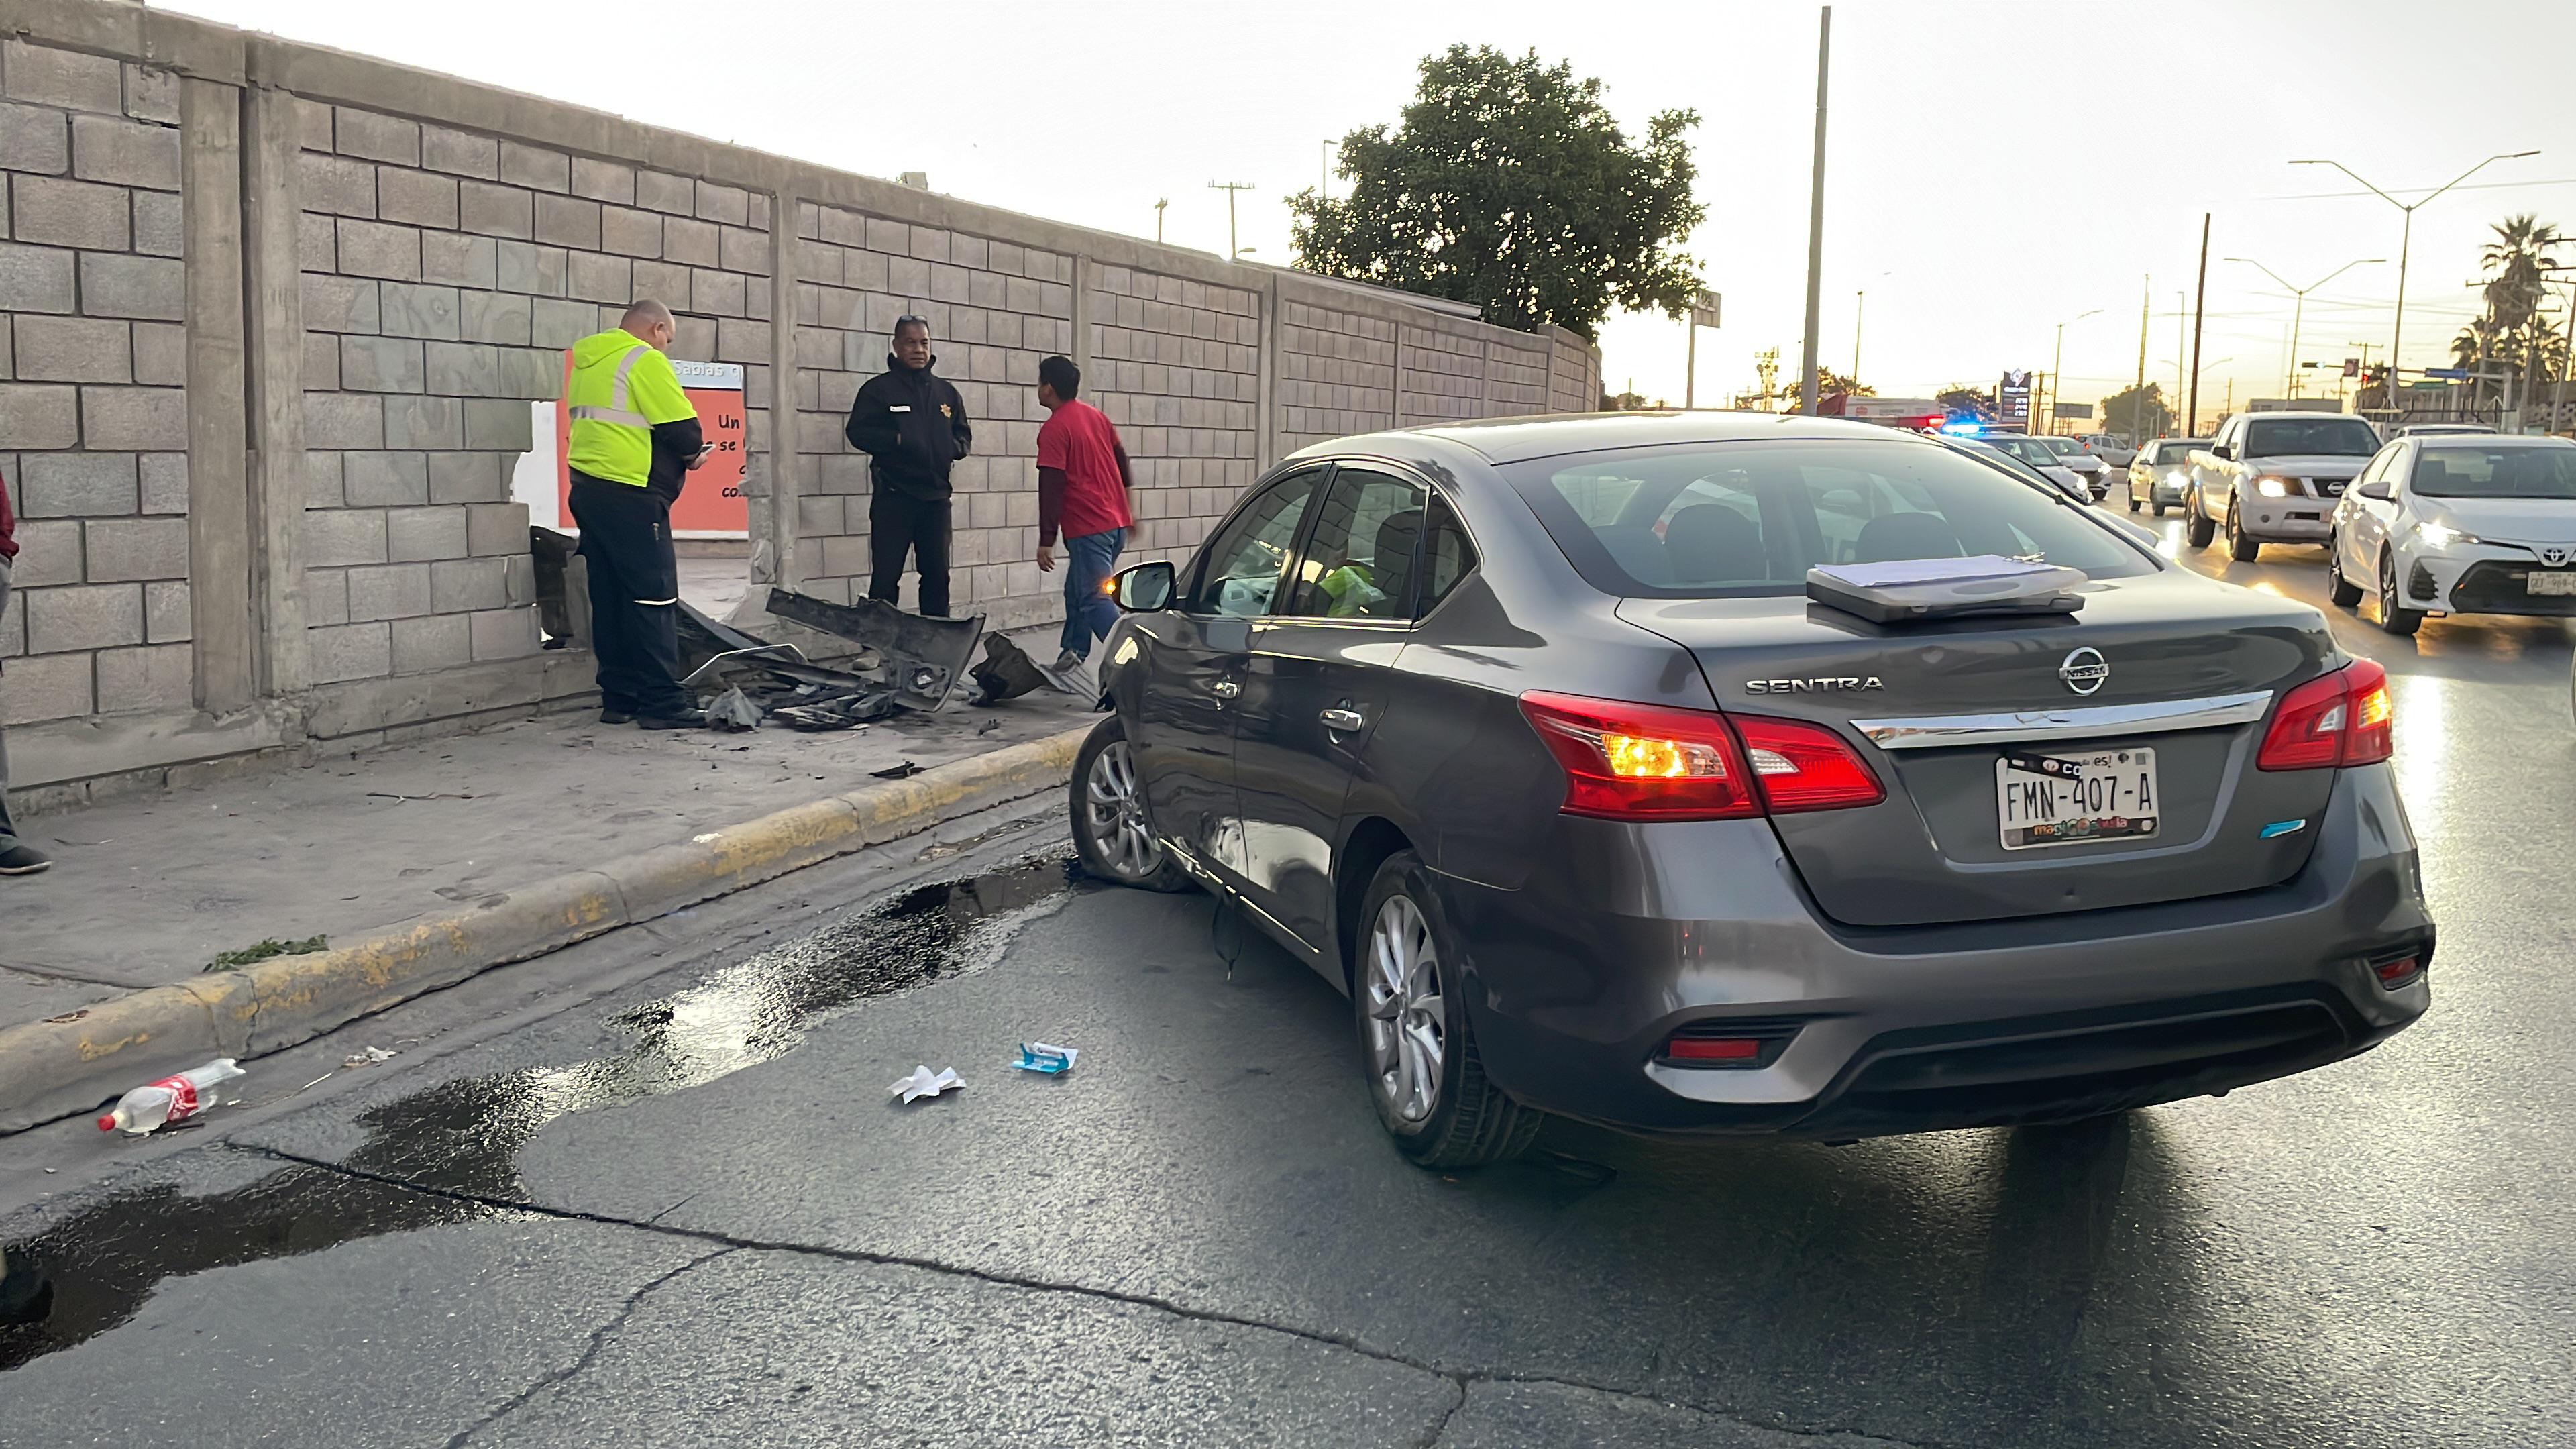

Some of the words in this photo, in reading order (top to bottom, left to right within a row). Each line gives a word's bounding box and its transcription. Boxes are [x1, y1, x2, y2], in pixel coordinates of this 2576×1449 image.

[718, 414, 740, 429] Un
[719, 441, 736, 451] se
[2066, 666, 2106, 678] NISSAN
[1746, 676, 1885, 695] SENTRA
[2094, 756, 2112, 769] es!
[2006, 772, 2152, 822] FMN-407-A
